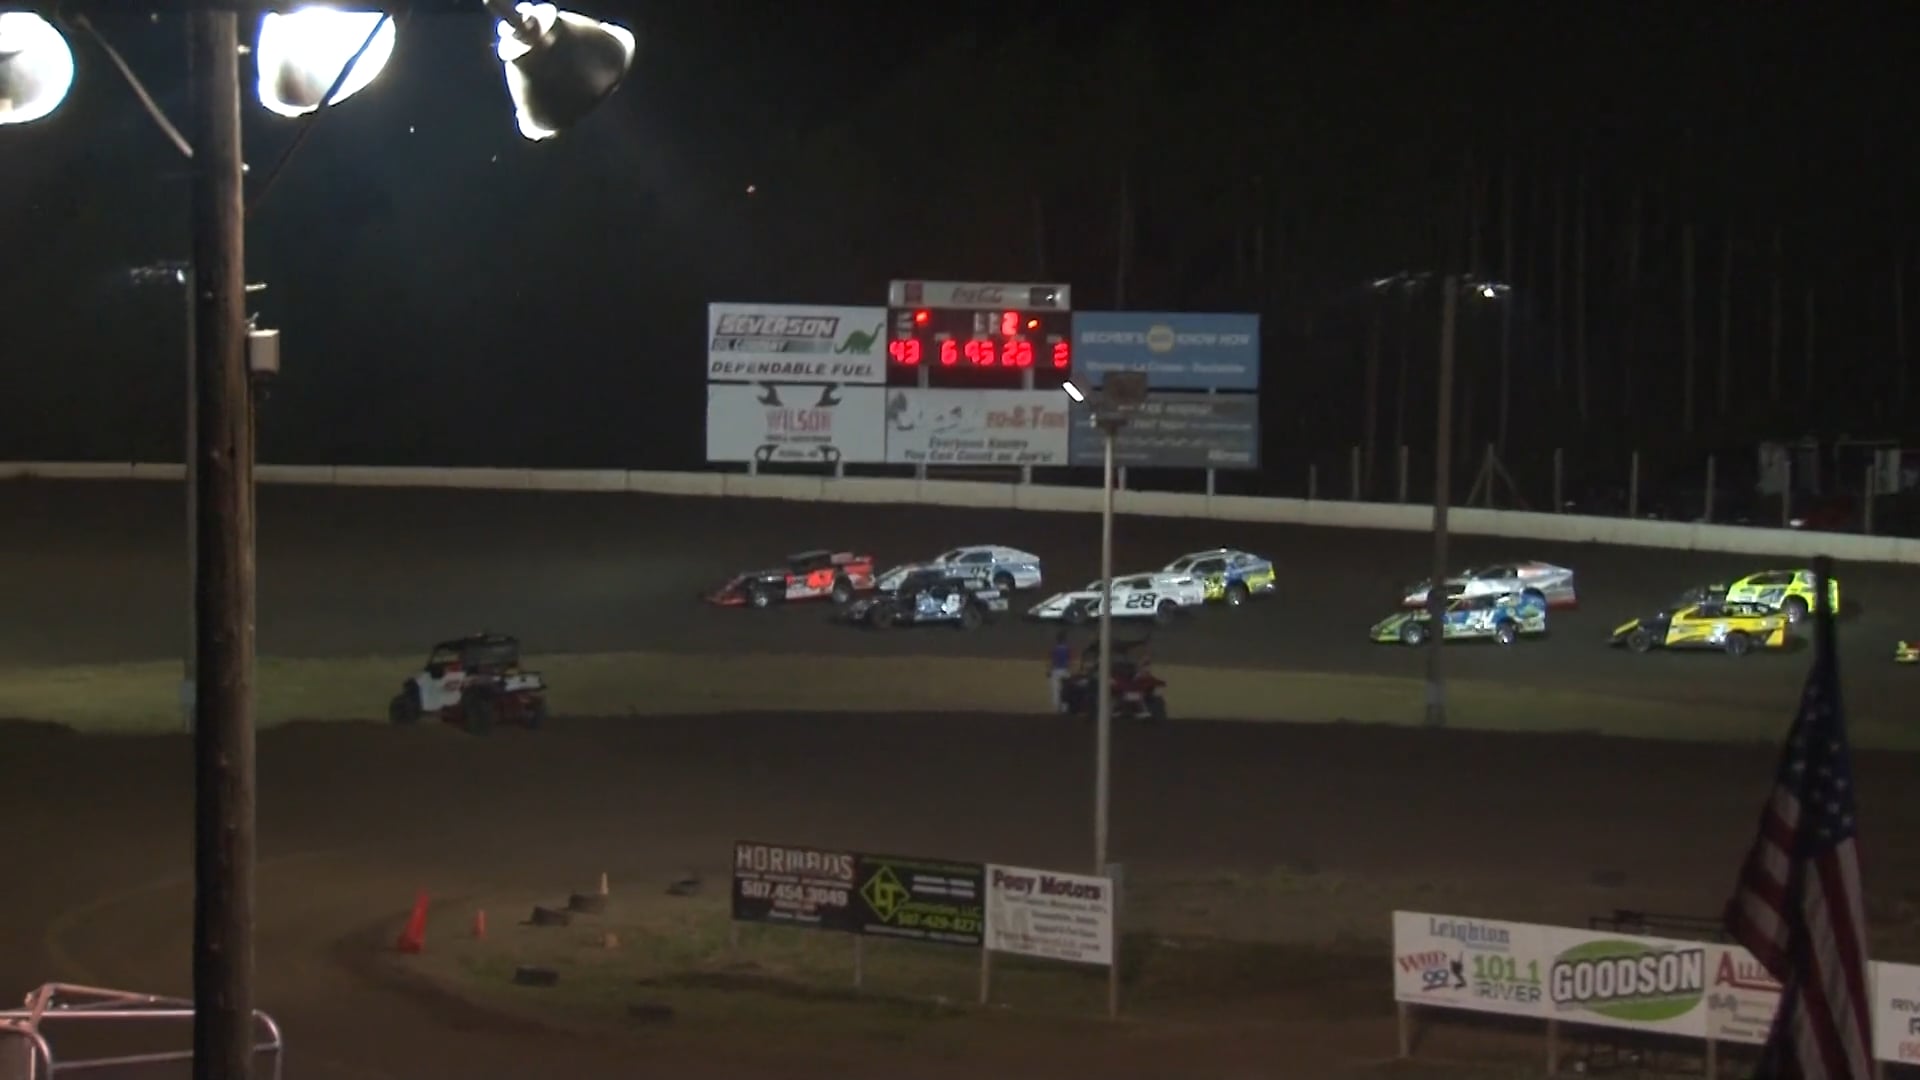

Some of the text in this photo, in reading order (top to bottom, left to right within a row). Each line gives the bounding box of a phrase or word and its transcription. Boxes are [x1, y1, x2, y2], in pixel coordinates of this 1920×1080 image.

[718, 315, 835, 337] SEVERSON
[889, 339, 920, 365] 43
[941, 340, 958, 365] 6
[711, 361, 875, 377] DEPENDABLE FUEL
[766, 410, 833, 432] WILSON
[1125, 593, 1158, 609] 28
[1041, 876, 1101, 900] Motors
[1430, 917, 1510, 944] Leighton
[1473, 954, 1541, 984] 101.1
[1552, 950, 1703, 1002] GOODSON
[1480, 982, 1542, 1002] RIVER
